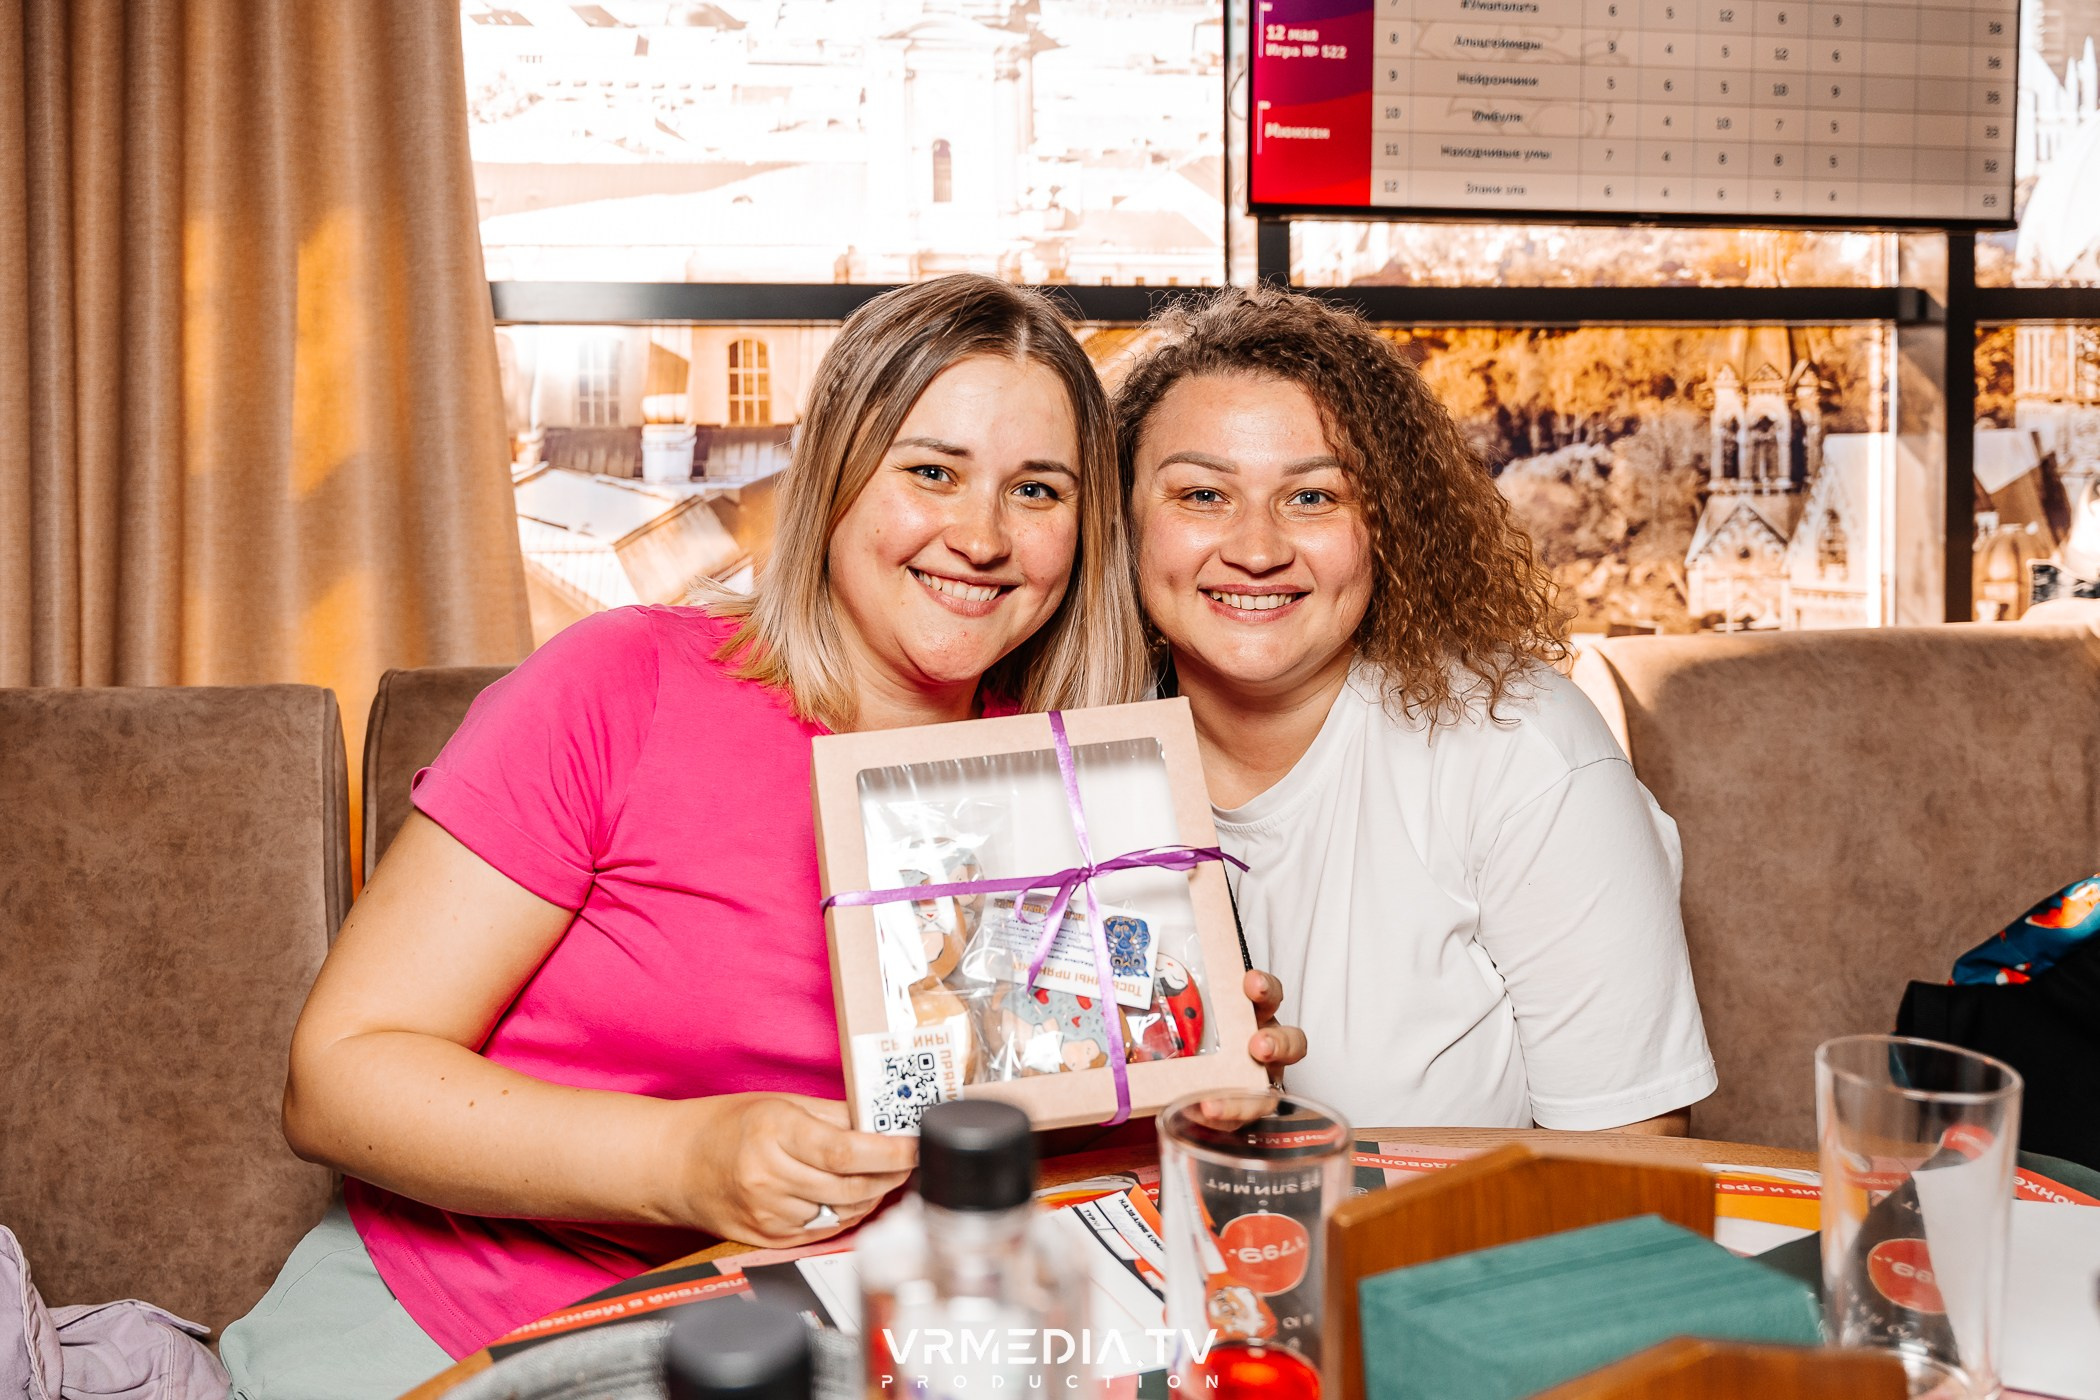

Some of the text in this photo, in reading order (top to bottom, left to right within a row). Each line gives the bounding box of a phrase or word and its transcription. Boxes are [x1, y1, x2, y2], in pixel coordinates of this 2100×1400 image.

[1266, 24, 1319, 41] 12 мая
[1265, 42, 1347, 59] Игра № 522
[1385, 106, 1400, 119] 10
[1716, 116, 1732, 130] 10
[1265, 122, 1330, 139] Мюнхен
[1385, 143, 1398, 156] 11
[1441, 144, 1552, 163] Находчивые умы
[1384, 180, 1398, 193] 12
[939, 1049, 957, 1101] ПРЯНИ
[1352, 1155, 1452, 1169] довольс
[1714, 1181, 1764, 1192] сре
[647, 1276, 749, 1305] льствий
[629, 1298, 644, 1309] в
